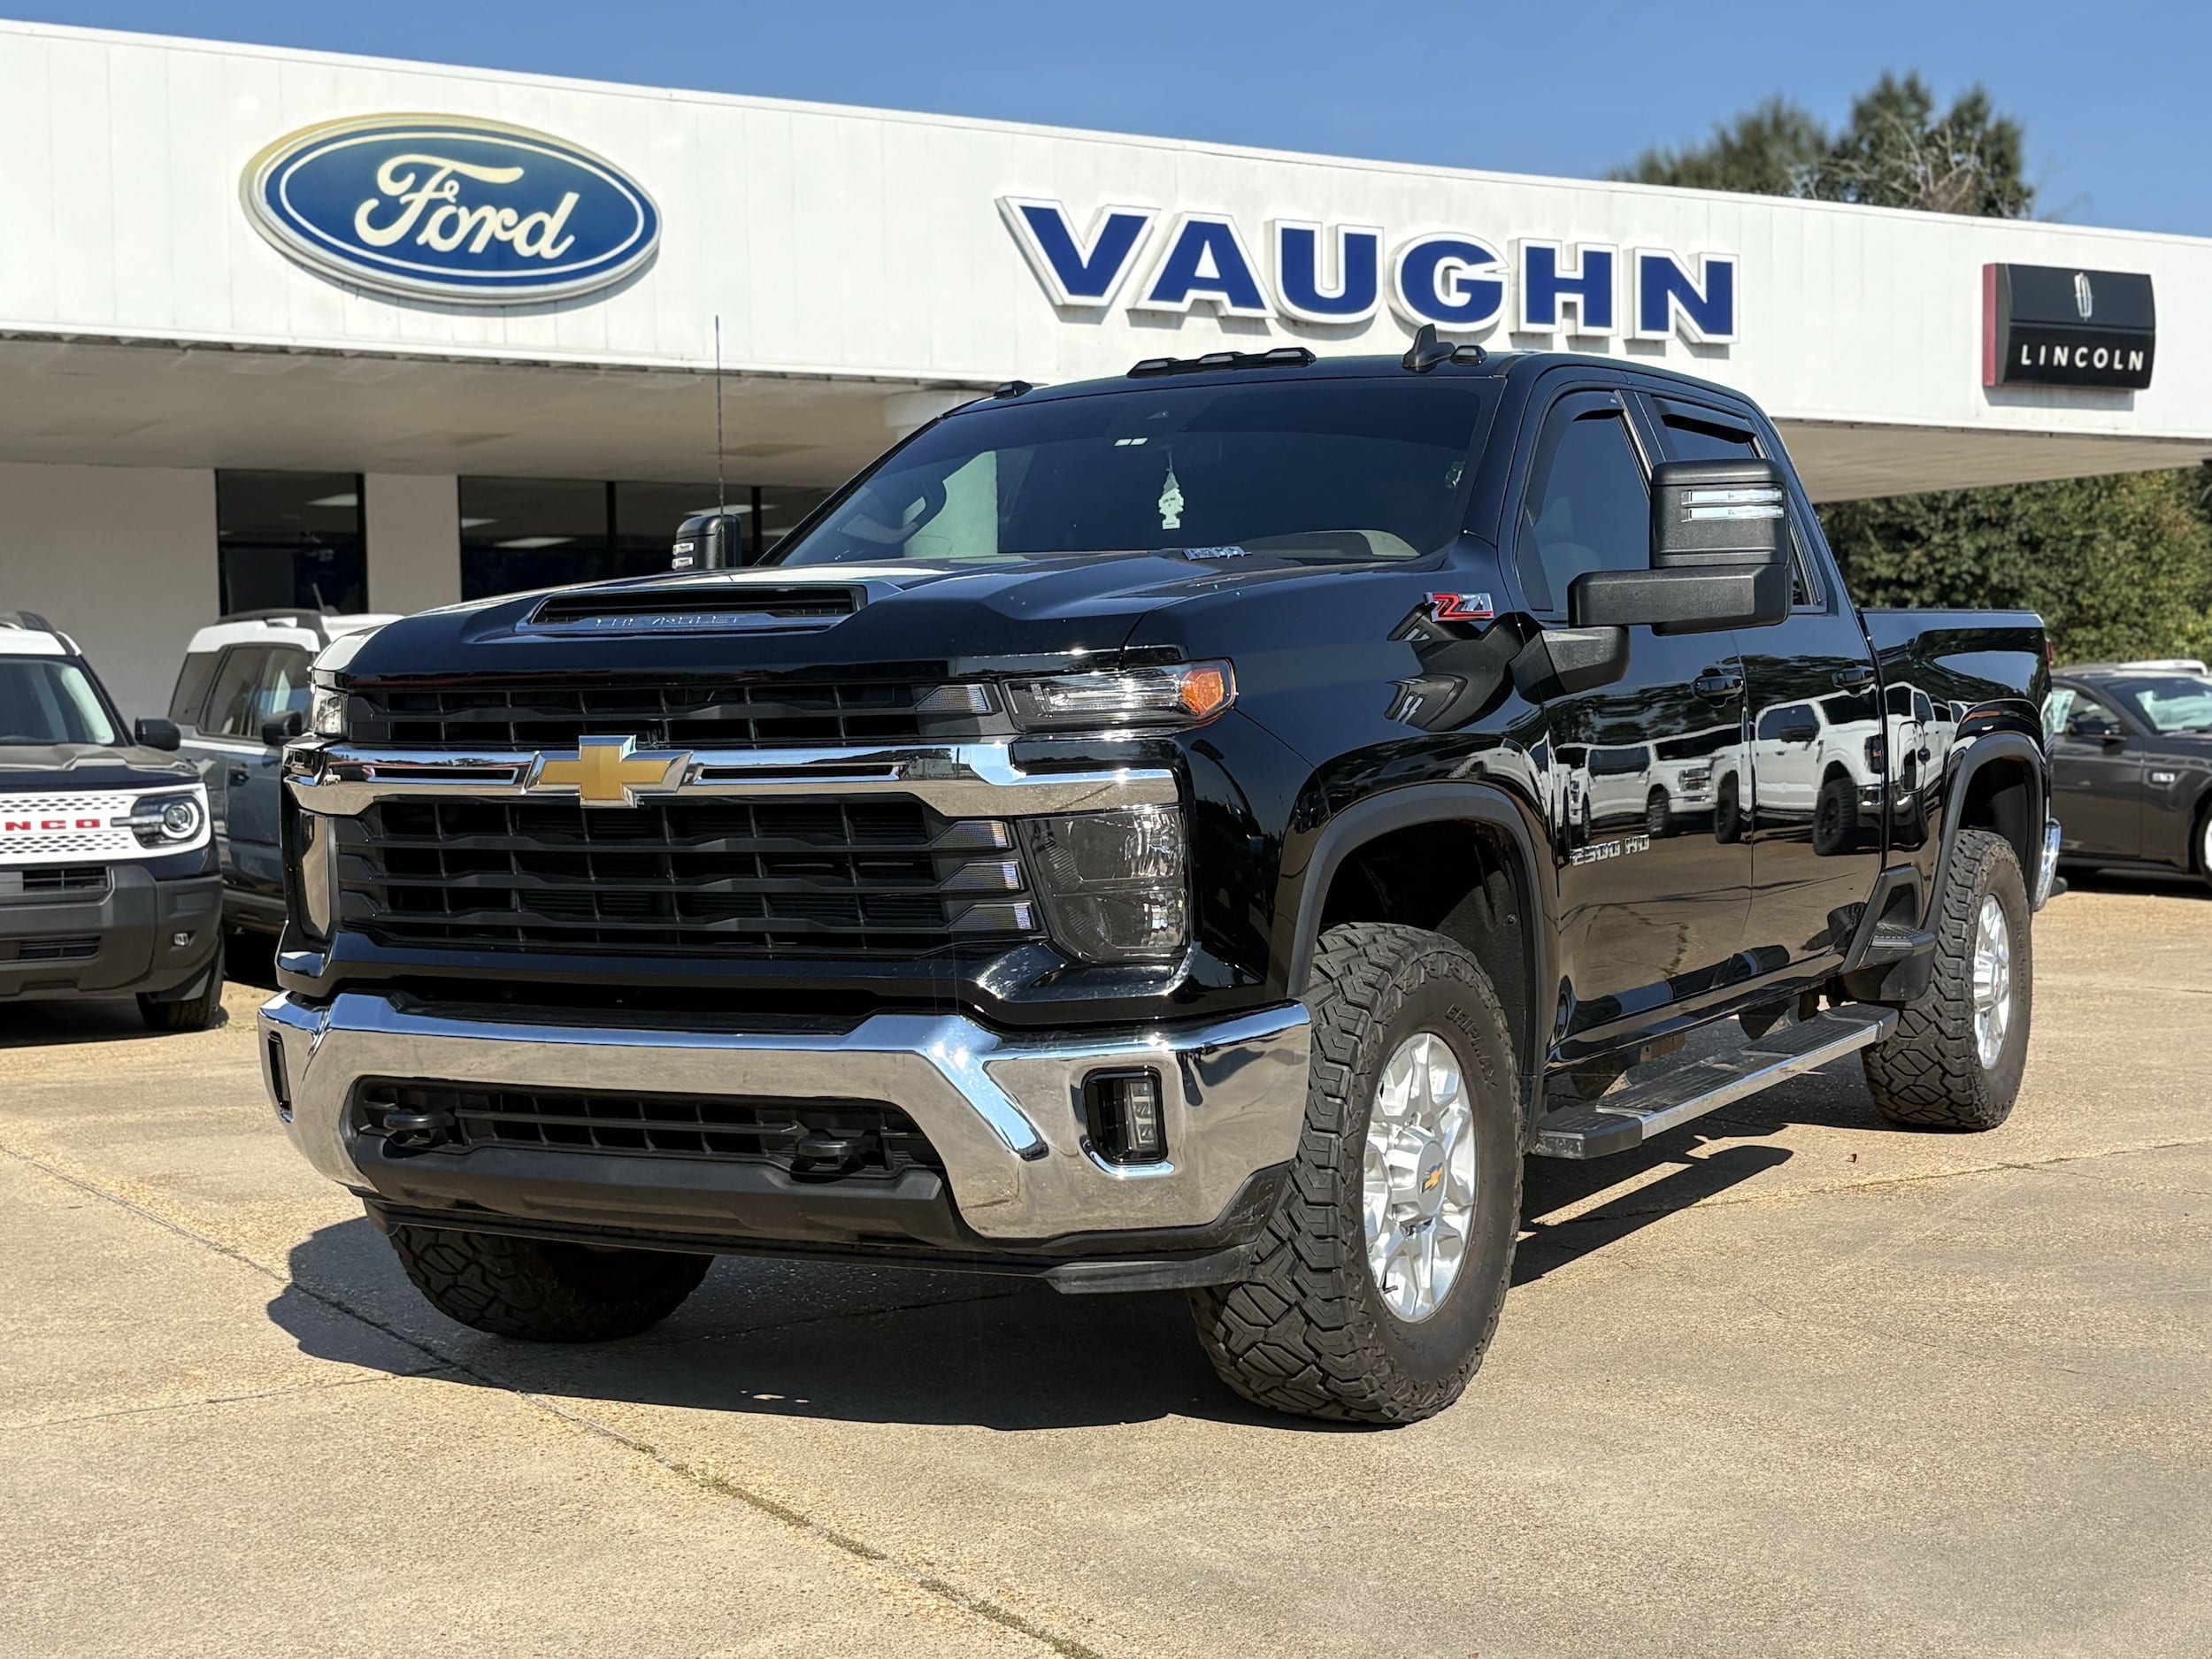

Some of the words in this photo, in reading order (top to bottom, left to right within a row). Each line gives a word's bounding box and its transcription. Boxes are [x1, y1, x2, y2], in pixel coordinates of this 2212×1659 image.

[354, 154, 580, 259] Ford
[1003, 197, 1740, 343] VAUGHN
[2021, 344, 2144, 371] LINCOLN
[1570, 841, 1620, 866] 2500
[1624, 834, 1649, 854] HD
